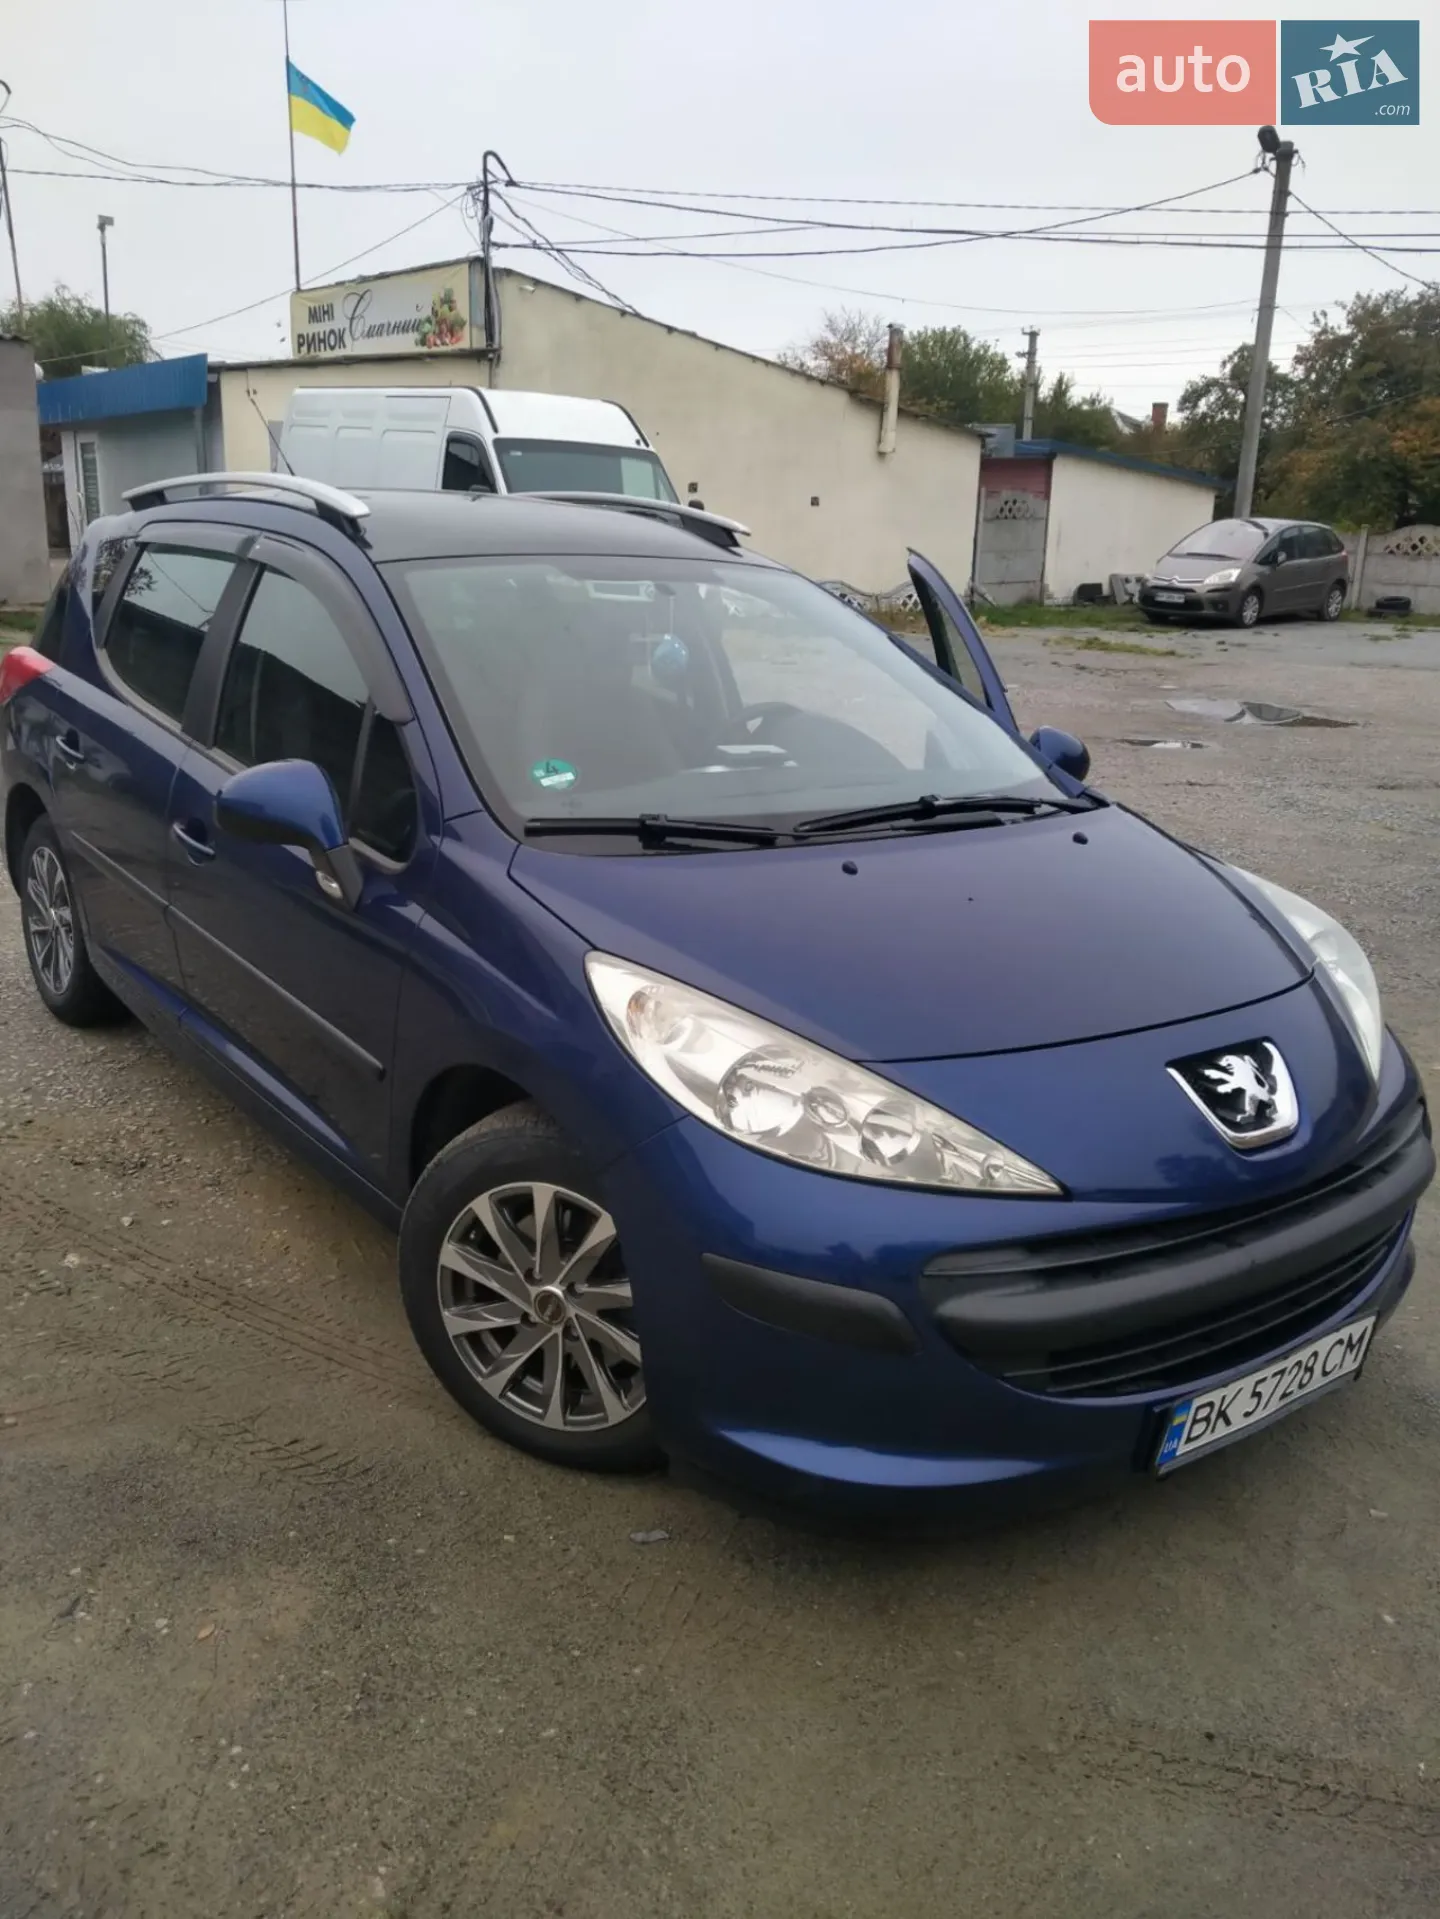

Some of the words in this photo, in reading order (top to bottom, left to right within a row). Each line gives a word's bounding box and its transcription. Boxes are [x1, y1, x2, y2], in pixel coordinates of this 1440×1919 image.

[308, 303, 335, 324] МІНІ
[297, 328, 347, 355] РИНОК
[1184, 1387, 1244, 1445] BK
[1242, 1350, 1319, 1418] 5728
[1321, 1325, 1369, 1377] CM
